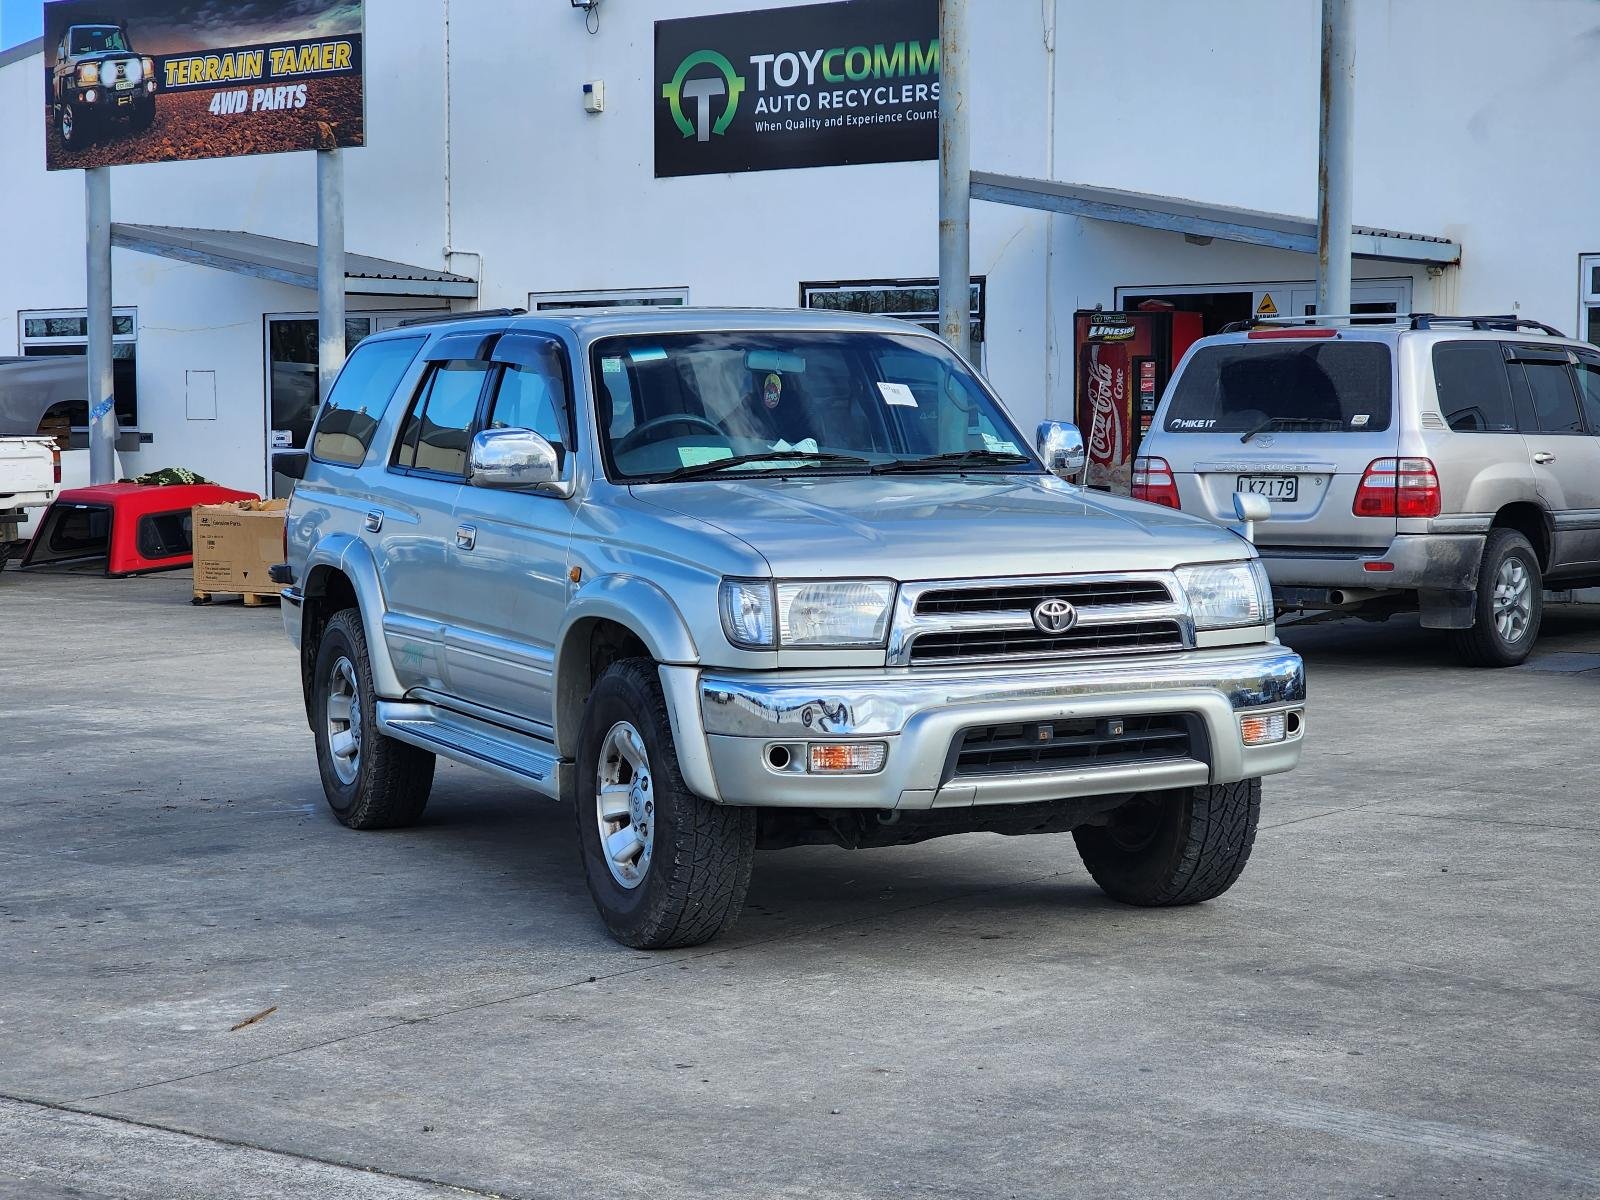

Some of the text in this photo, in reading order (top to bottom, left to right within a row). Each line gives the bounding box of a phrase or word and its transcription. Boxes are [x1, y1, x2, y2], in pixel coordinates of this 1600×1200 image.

[165, 42, 352, 87] TERRAIN TAMER
[750, 39, 939, 91] TOYCOMM
[208, 84, 307, 115] 4WD PARTS
[754, 82, 939, 114] AUTO RECYCLERS
[755, 121, 782, 132] When
[785, 117, 821, 131] Quality
[824, 115, 843, 127] and
[846, 112, 903, 126] Experience
[1113, 368, 1124, 400] Coke
[1215, 463, 1312, 472] LAND CRUISER
